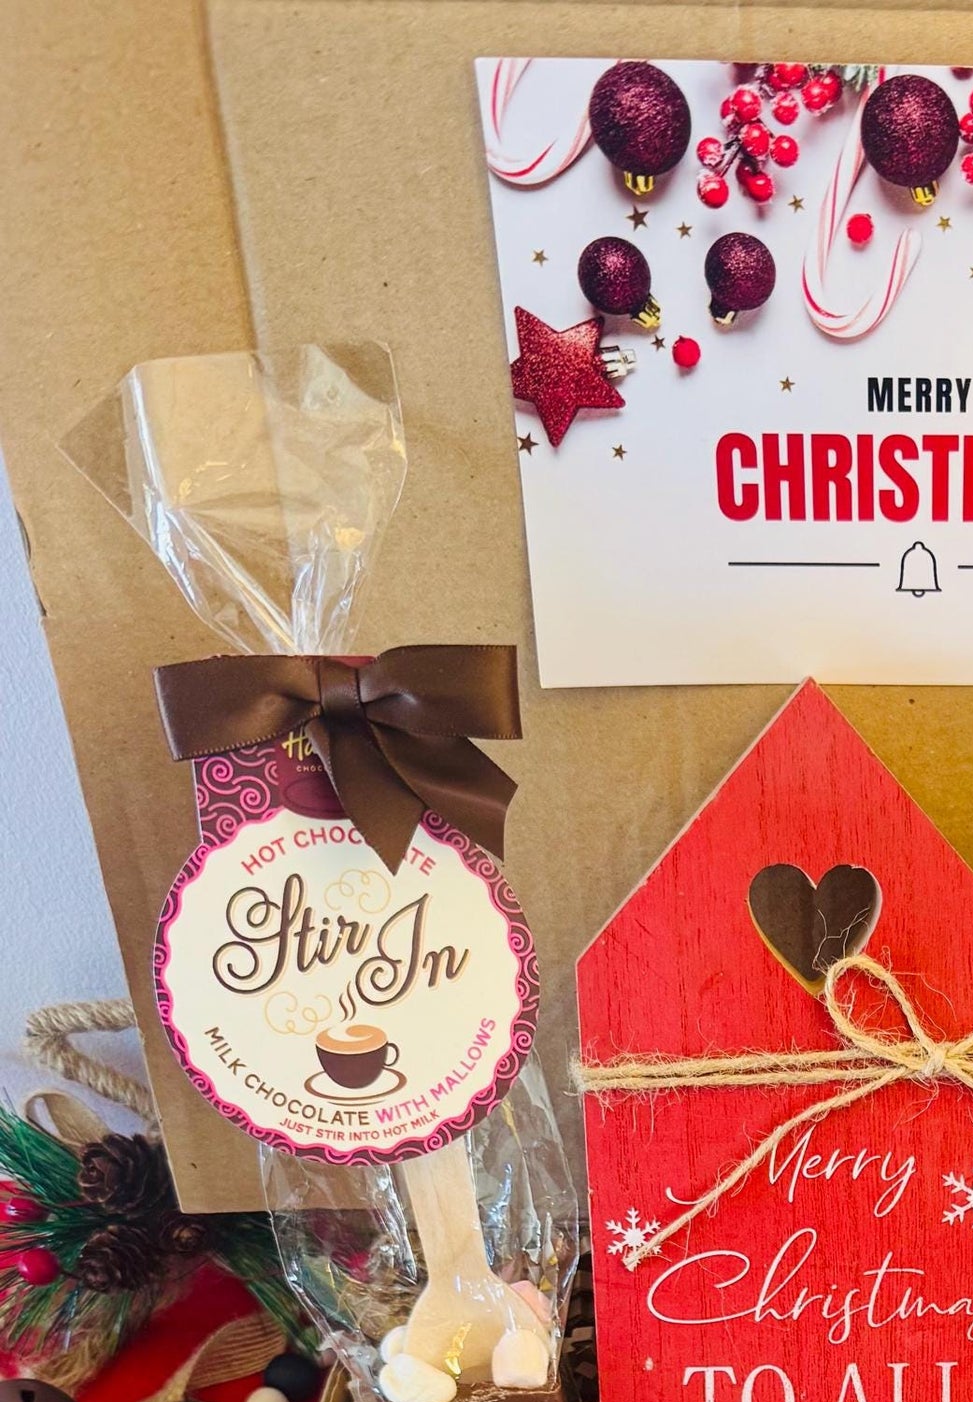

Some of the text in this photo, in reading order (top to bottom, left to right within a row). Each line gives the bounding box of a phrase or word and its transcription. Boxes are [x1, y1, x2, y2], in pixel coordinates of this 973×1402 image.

[867, 377, 972, 413] MERRY
[241, 826, 436, 877] HOT CHOCTE
[212, 872, 470, 1008] Stir In
[204, 1017, 496, 1126] MILK CHOCOLATE WITH MALLOWS
[280, 1110, 441, 1142] JUST STIR INTO HOT MILK
